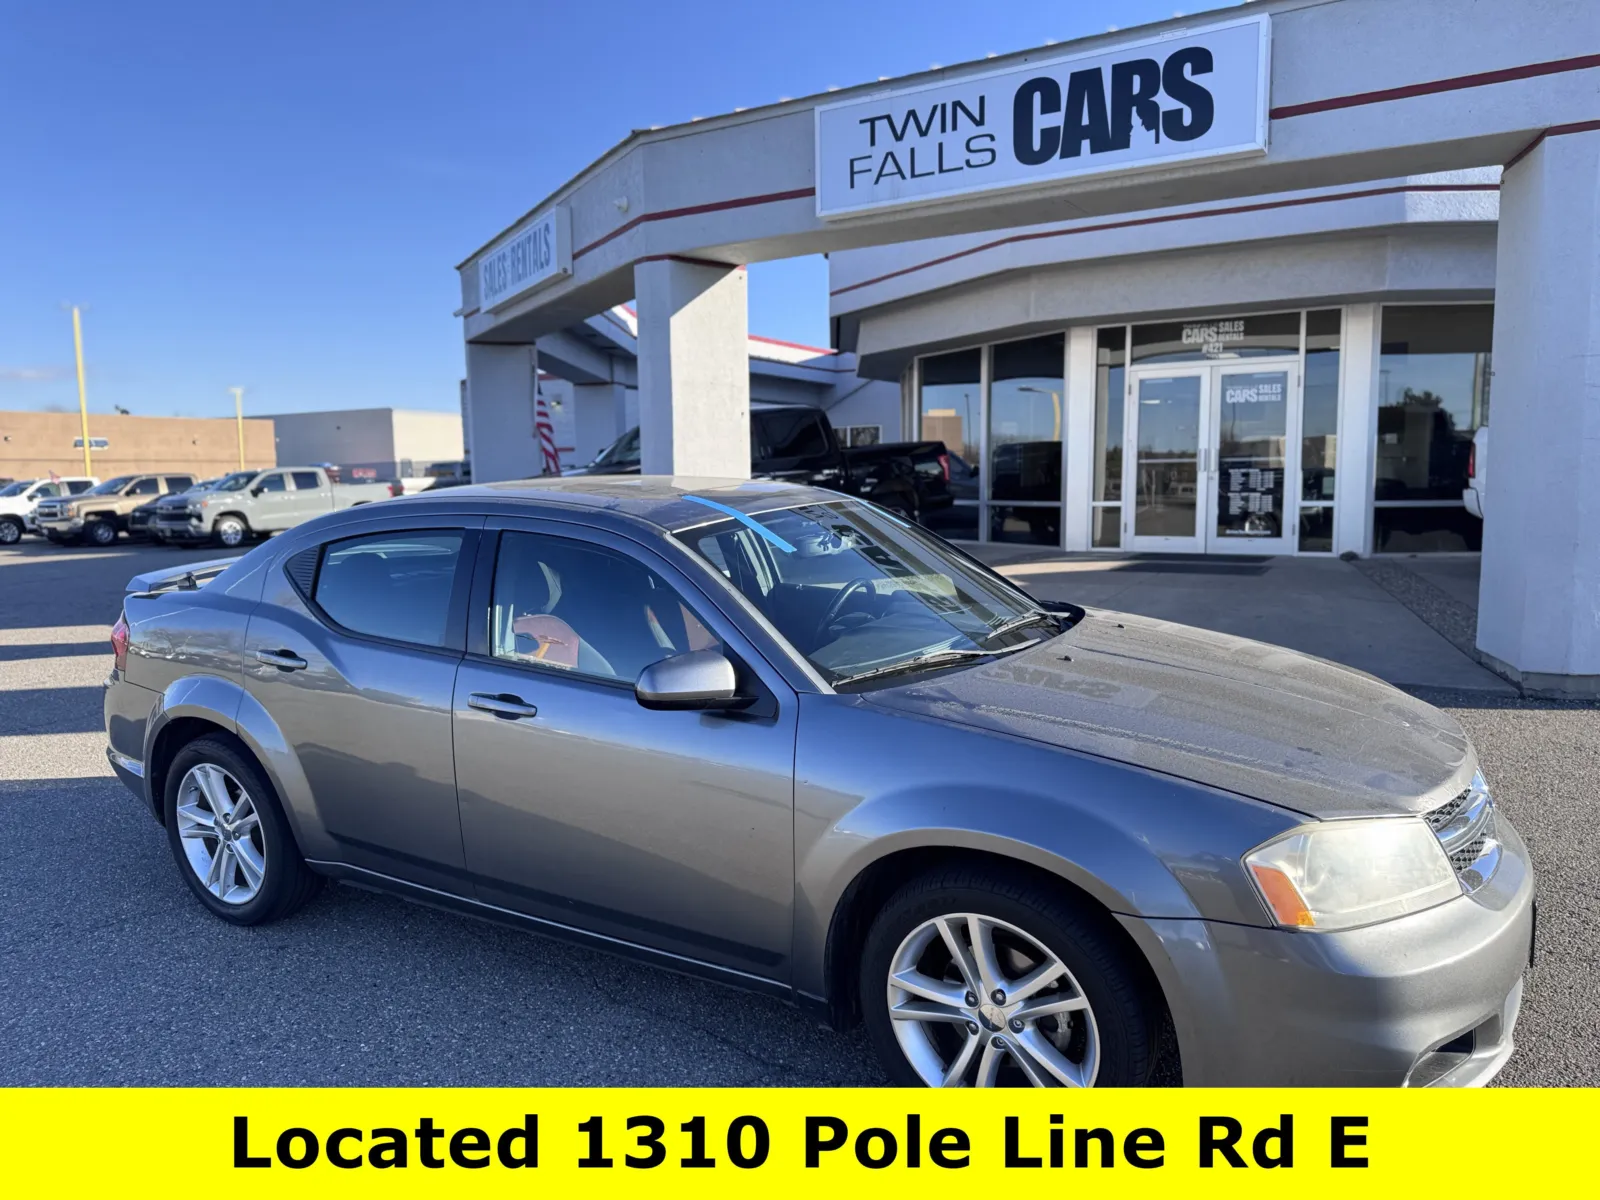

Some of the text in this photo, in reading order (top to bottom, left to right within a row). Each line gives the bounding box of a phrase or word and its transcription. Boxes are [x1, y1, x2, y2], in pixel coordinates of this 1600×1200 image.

[859, 95, 985, 147] TWIN
[1013, 46, 1214, 165] CARS
[850, 133, 996, 189] FALLS
[484, 222, 550, 300] SALES RENTALS
[1182, 327, 1218, 344] CARS
[1218, 320, 1245, 332] SALES
[1226, 388, 1258, 403] CARS
[1258, 384, 1282, 393] SALES
